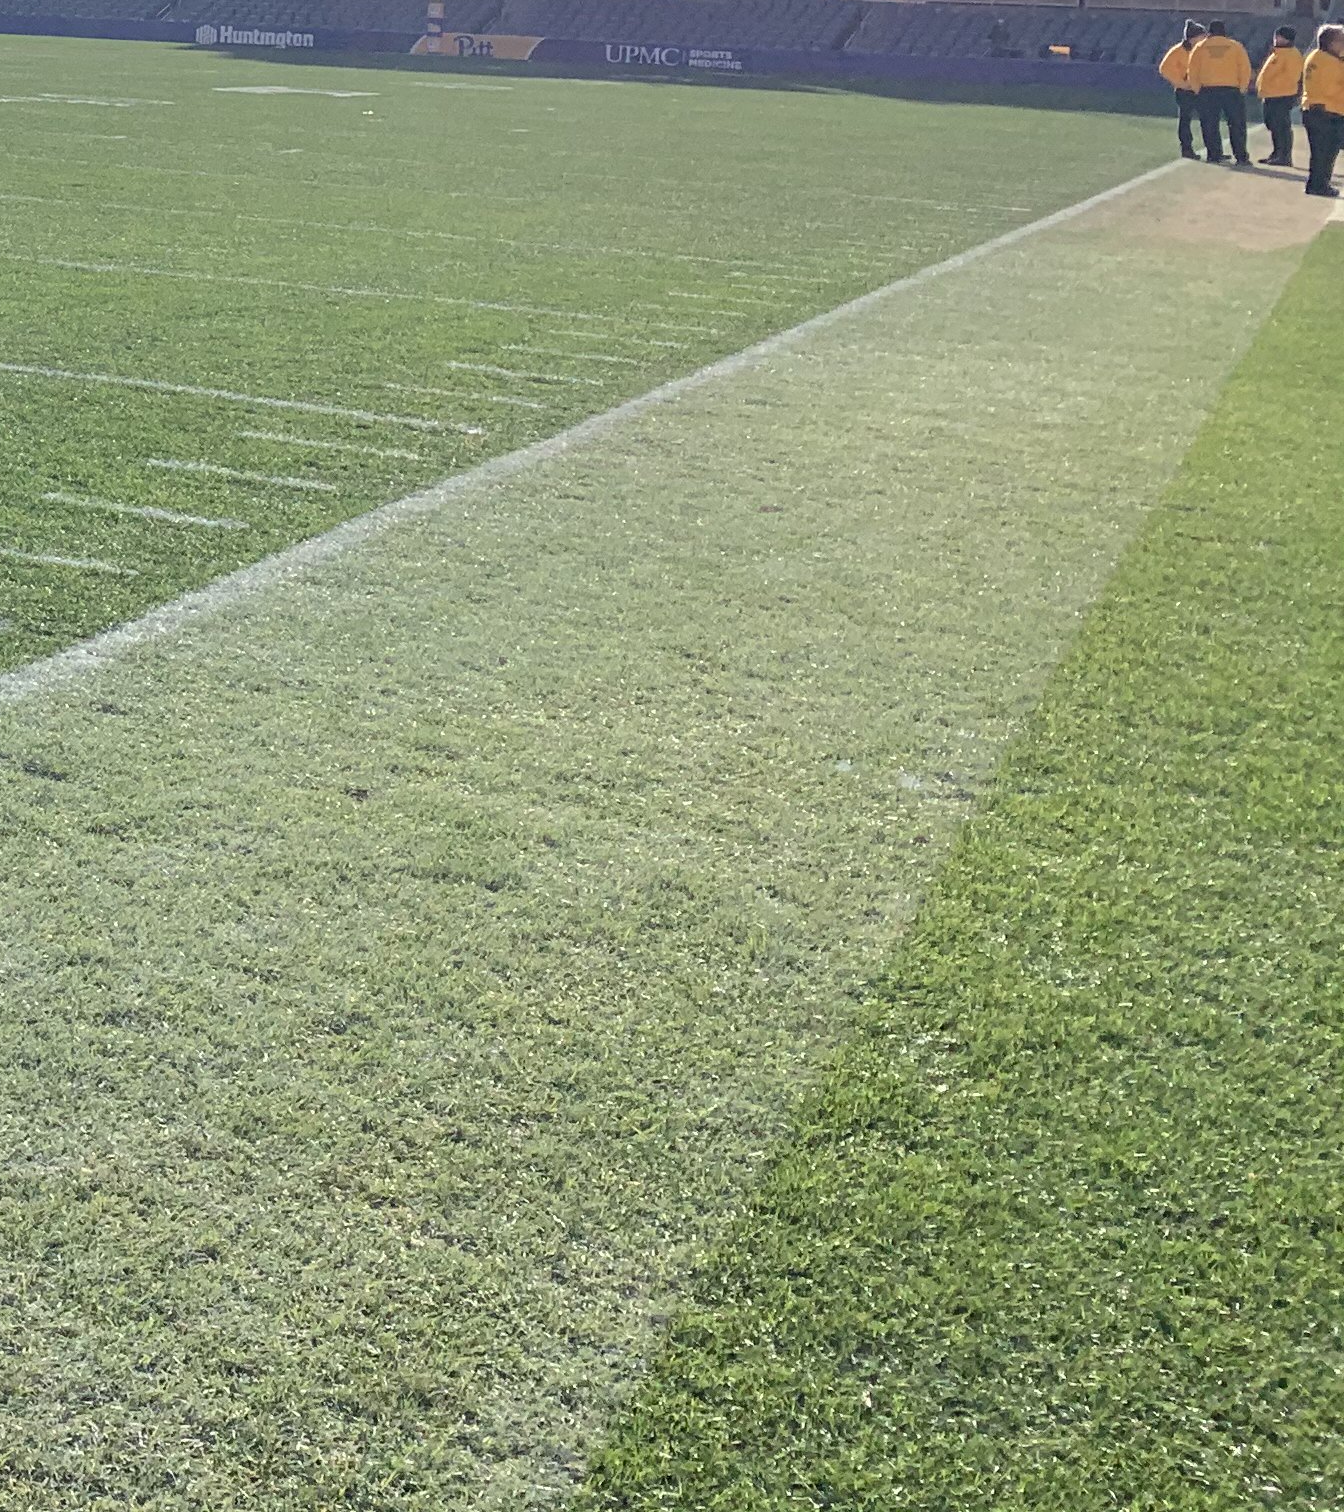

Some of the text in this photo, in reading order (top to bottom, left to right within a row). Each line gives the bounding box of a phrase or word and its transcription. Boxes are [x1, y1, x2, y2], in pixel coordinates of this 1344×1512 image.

[219, 26, 314, 49] Huntington
[453, 35, 494, 58] Pitt
[605, 44, 680, 66] UPMC
